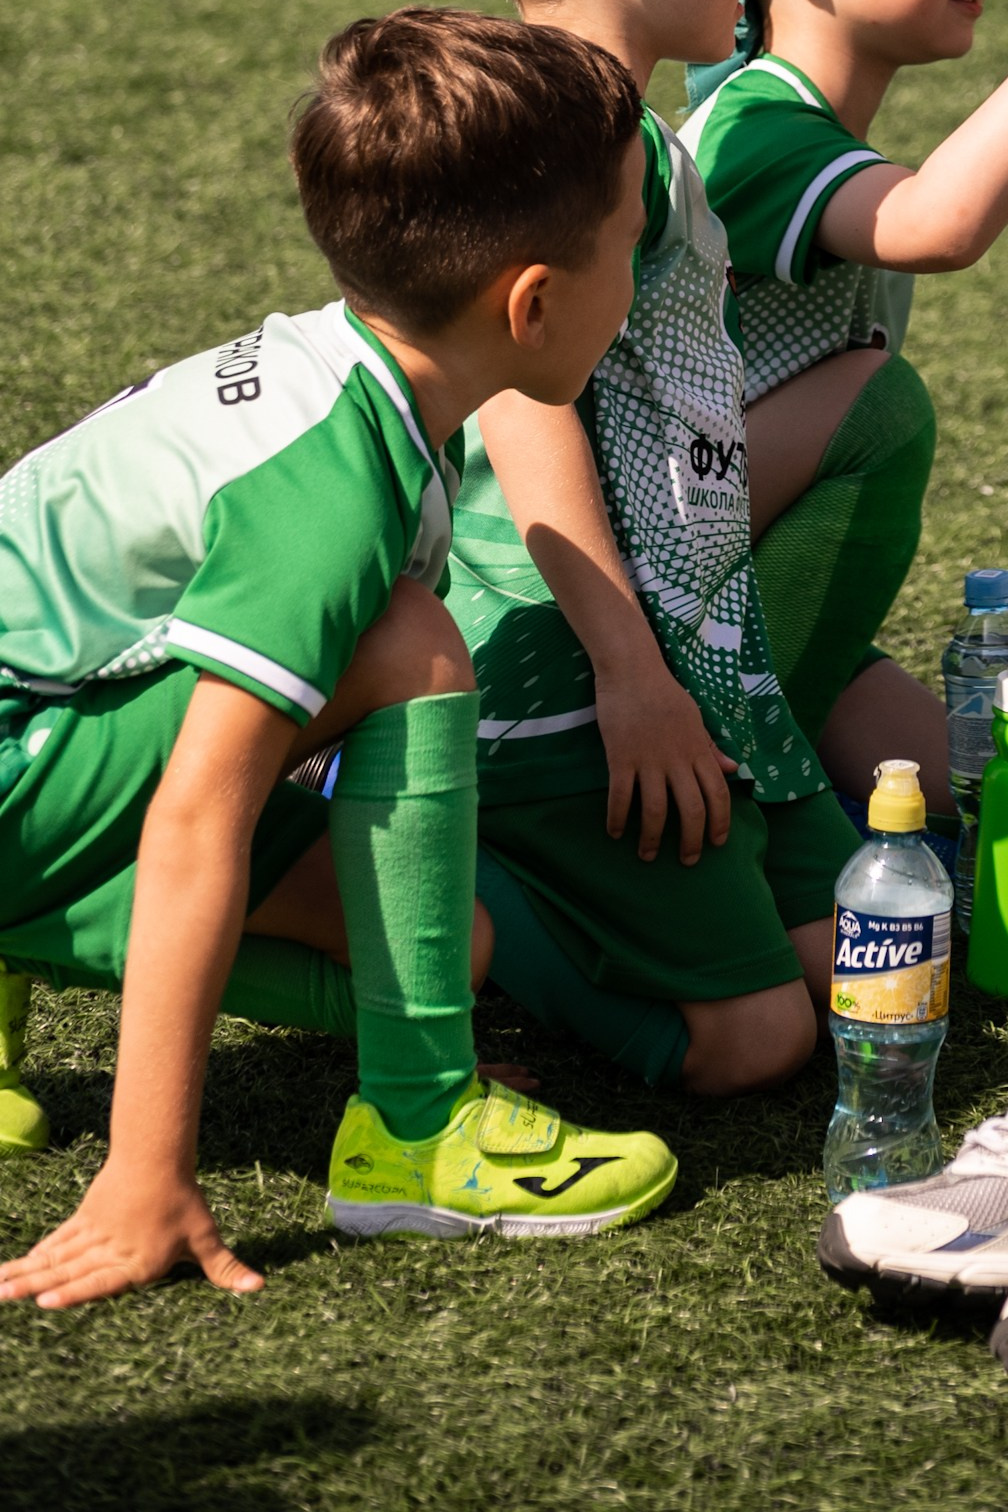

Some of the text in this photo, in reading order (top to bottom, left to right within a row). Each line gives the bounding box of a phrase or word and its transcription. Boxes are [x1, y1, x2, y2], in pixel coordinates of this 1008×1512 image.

[687, 486, 734, 511] ШКОЛА
[839, 917, 861, 934] AQUA
[868, 920, 880, 932] Mg
[881, 922, 888, 931] K
